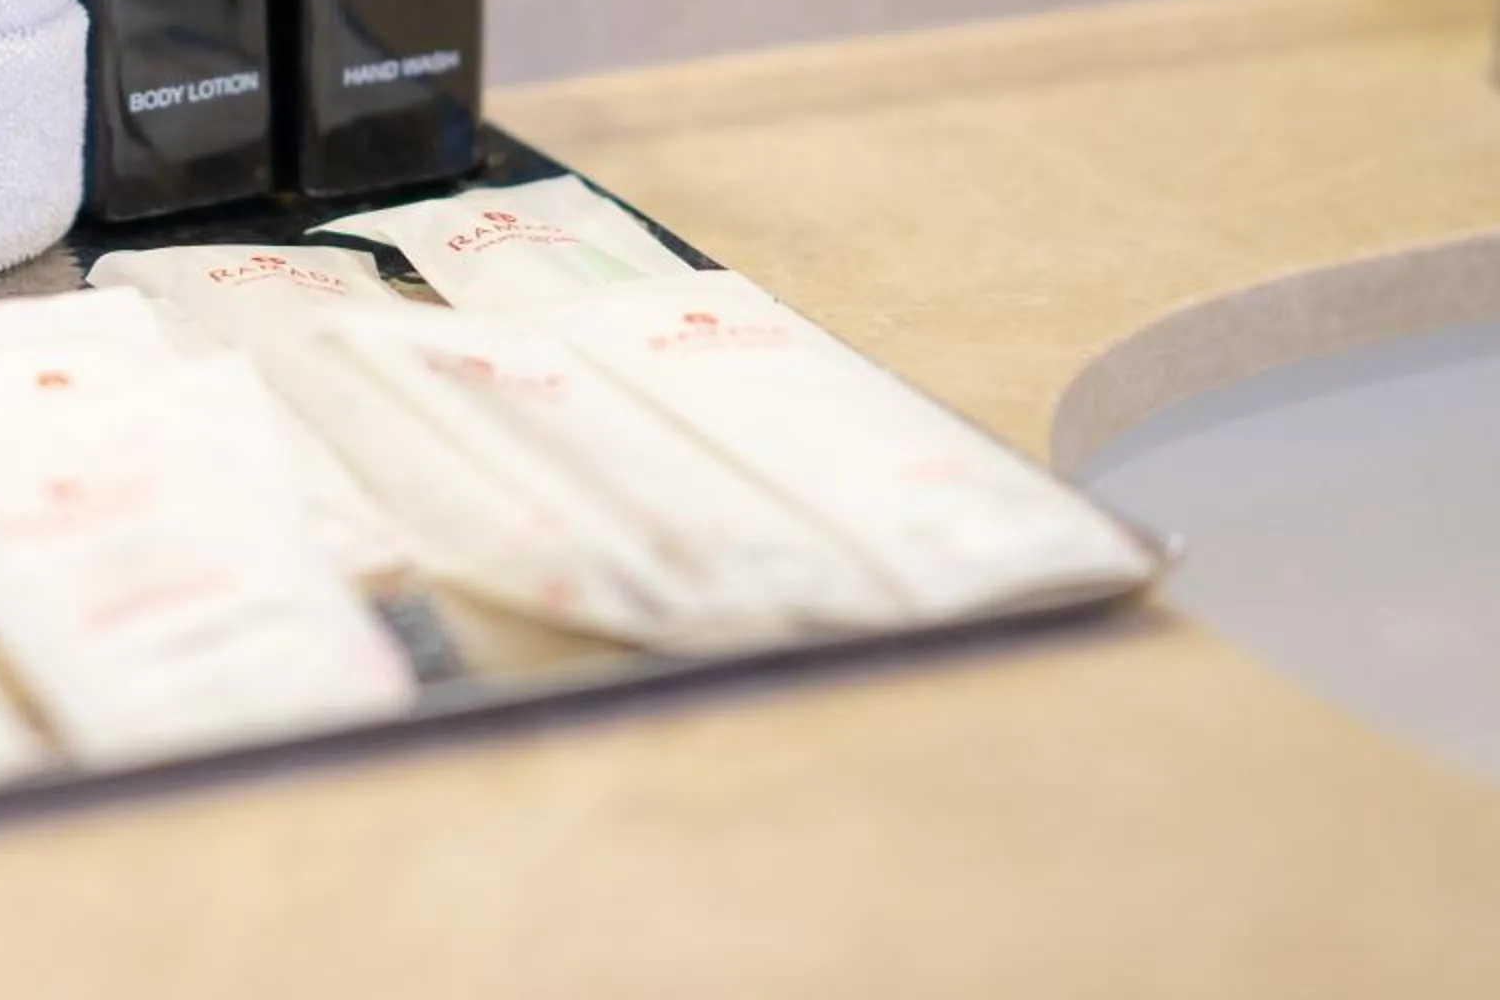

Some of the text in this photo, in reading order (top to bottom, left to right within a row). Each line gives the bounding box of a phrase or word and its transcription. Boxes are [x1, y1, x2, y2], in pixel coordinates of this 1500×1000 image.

[343, 51, 460, 86] HAND WASH
[129, 71, 259, 112] BODY LOTION
